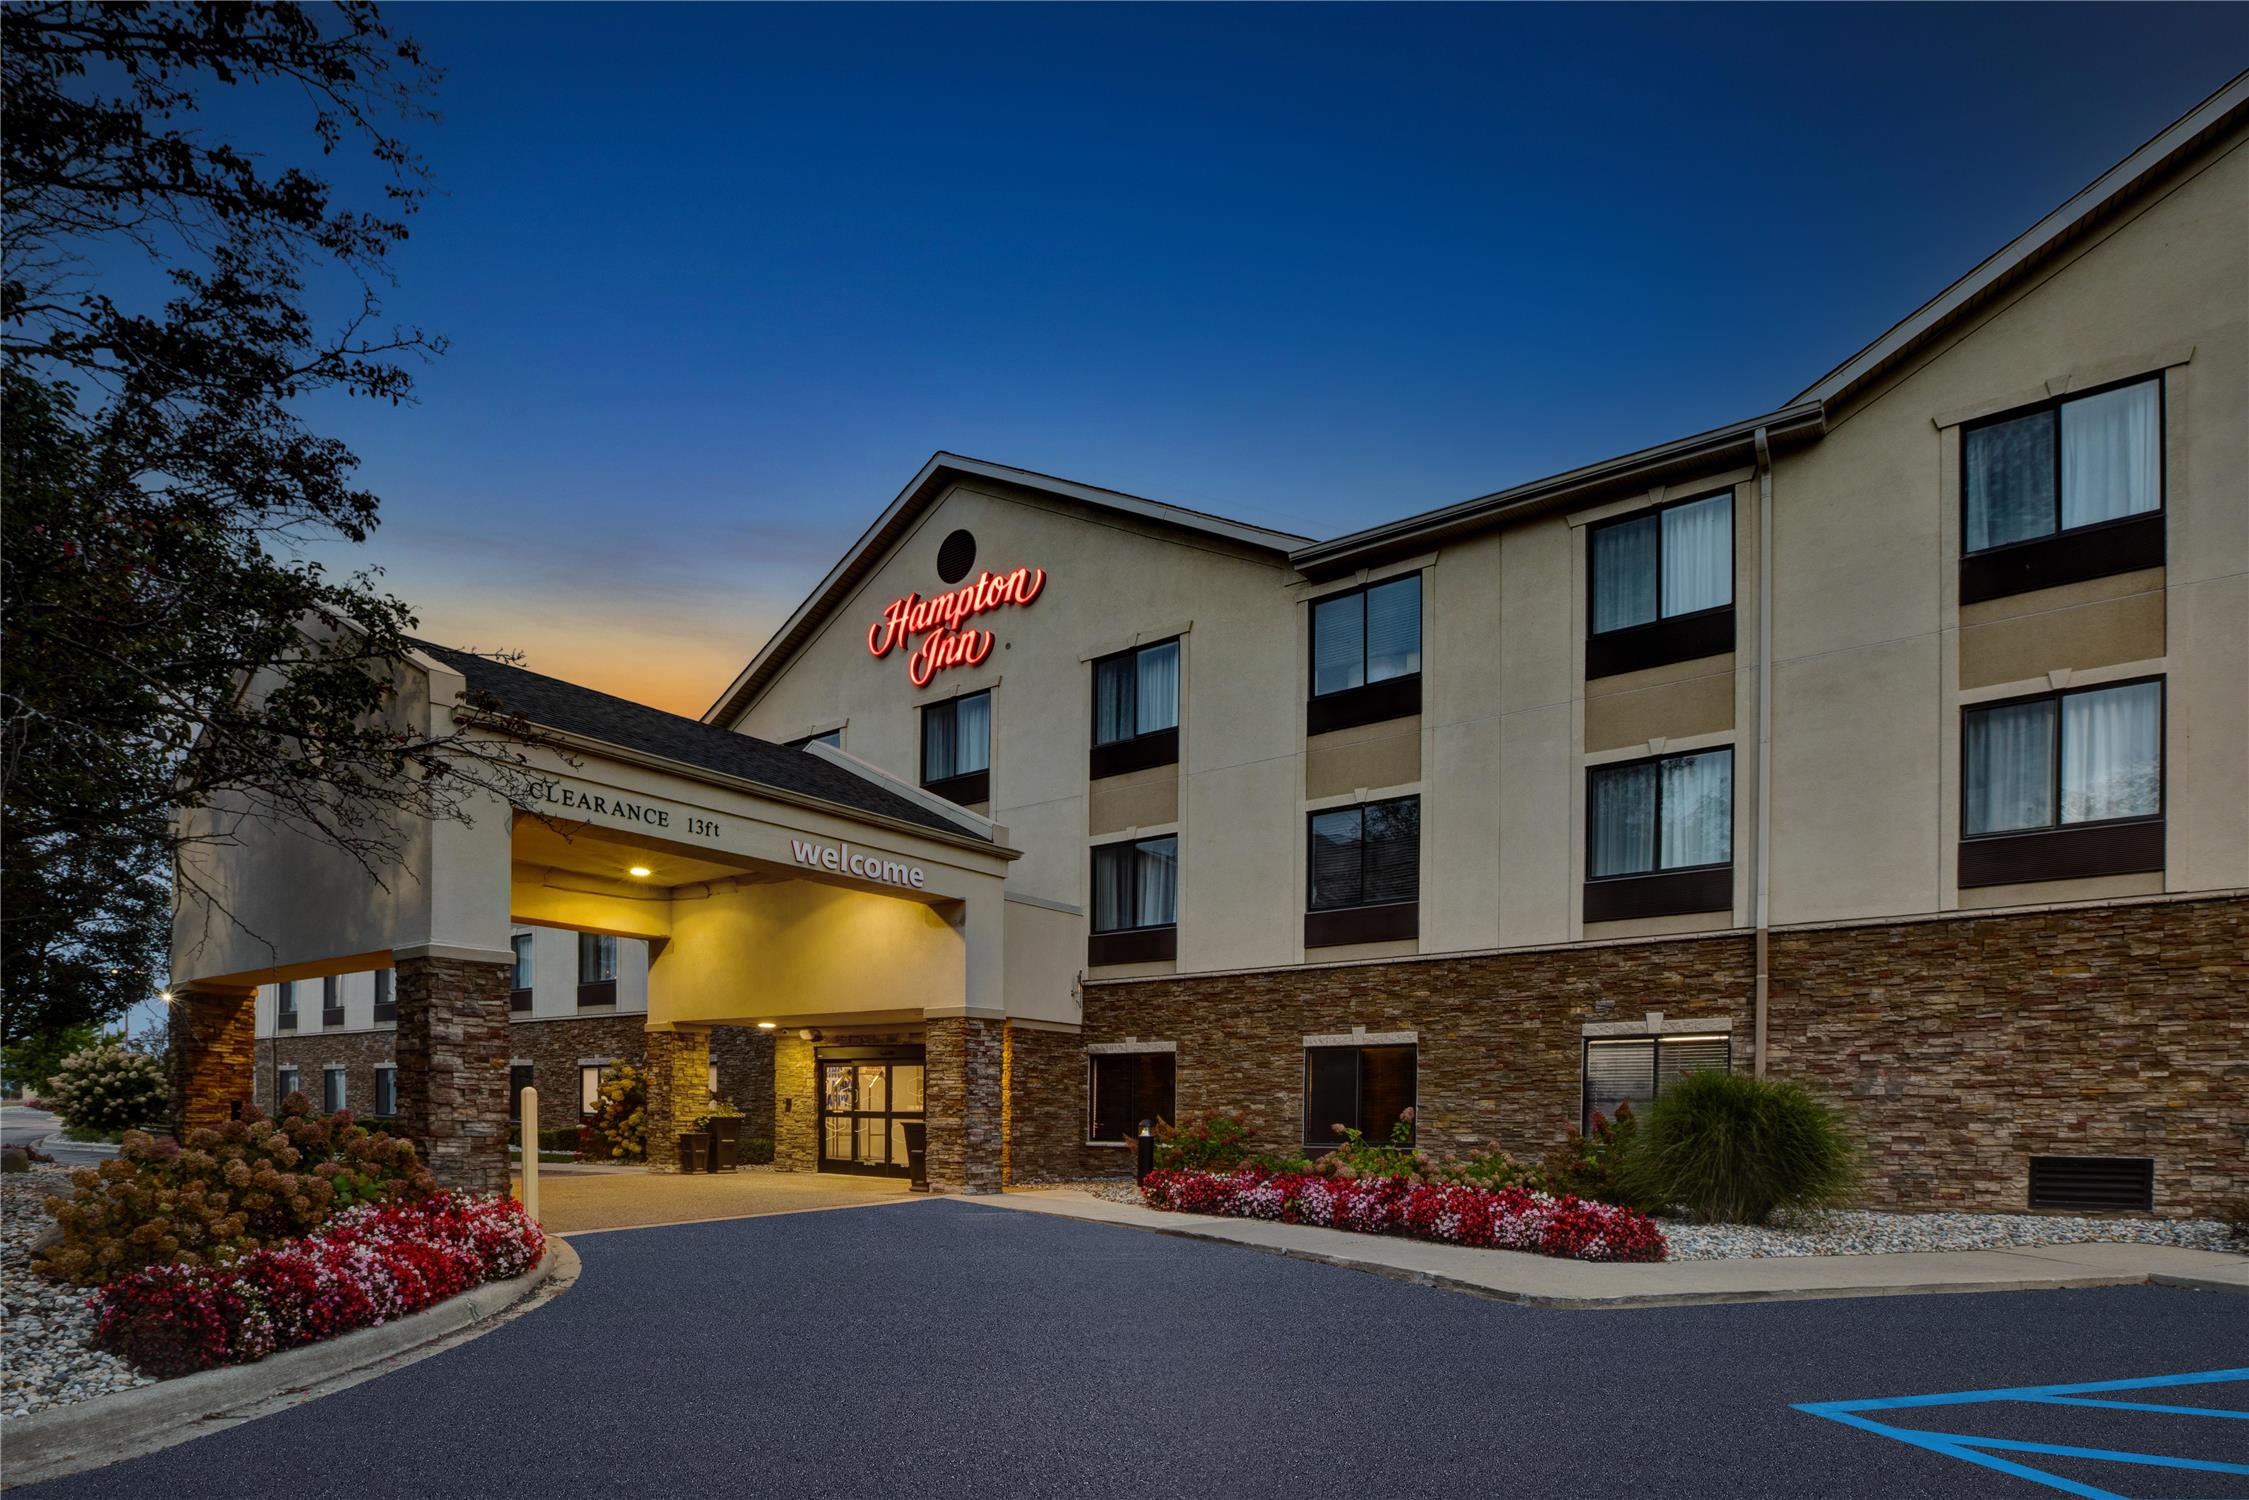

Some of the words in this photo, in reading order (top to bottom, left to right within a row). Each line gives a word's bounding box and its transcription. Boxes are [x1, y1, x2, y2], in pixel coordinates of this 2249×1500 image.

[868, 568, 1046, 657] Hampton
[910, 627, 995, 687] Inn
[530, 782, 669, 827] CLEARANCE
[687, 818, 720, 837] 13ft
[791, 840, 924, 888] welcome
